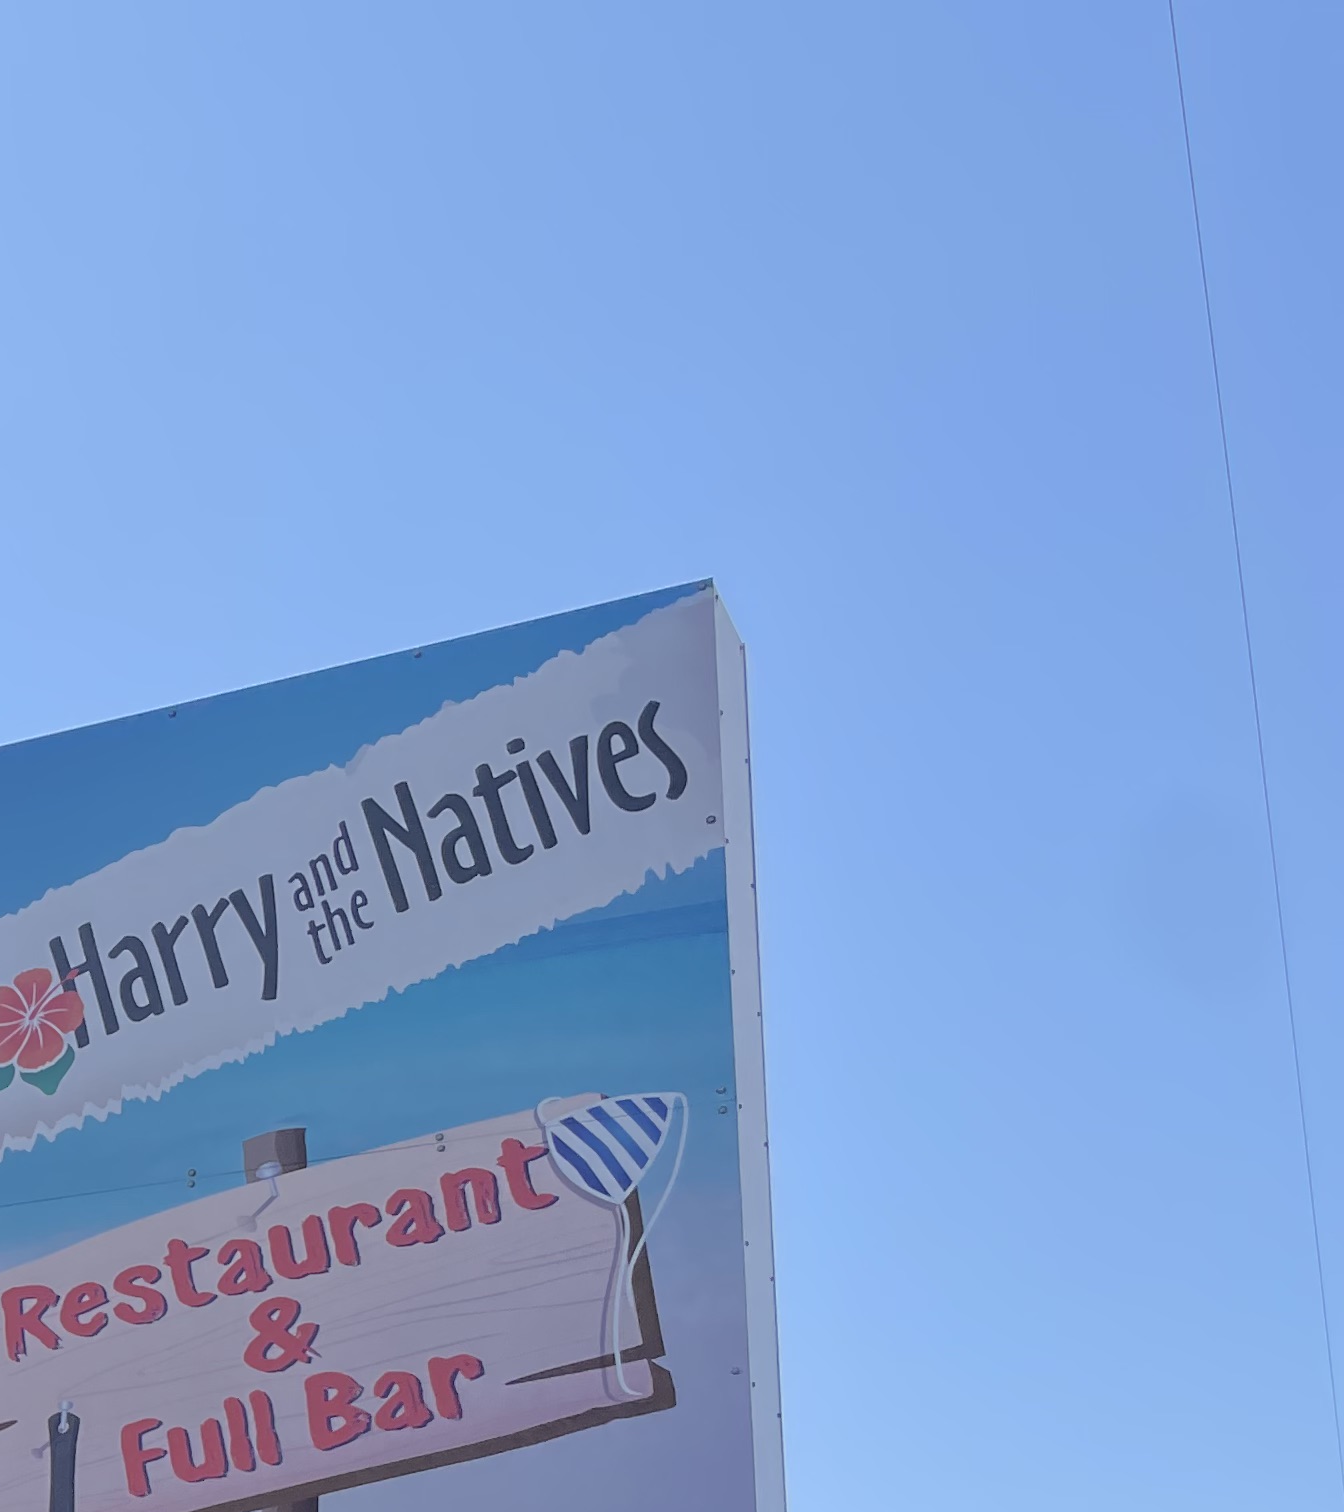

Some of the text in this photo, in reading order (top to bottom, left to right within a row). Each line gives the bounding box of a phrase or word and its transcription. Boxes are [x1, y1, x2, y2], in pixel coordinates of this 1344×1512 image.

[49, 700, 688, 1050] Harry and the Natives
[1, 1138, 559, 1363] Restaurant
[244, 1297, 318, 1373] &
[120, 1354, 485, 1498] Full Bar
